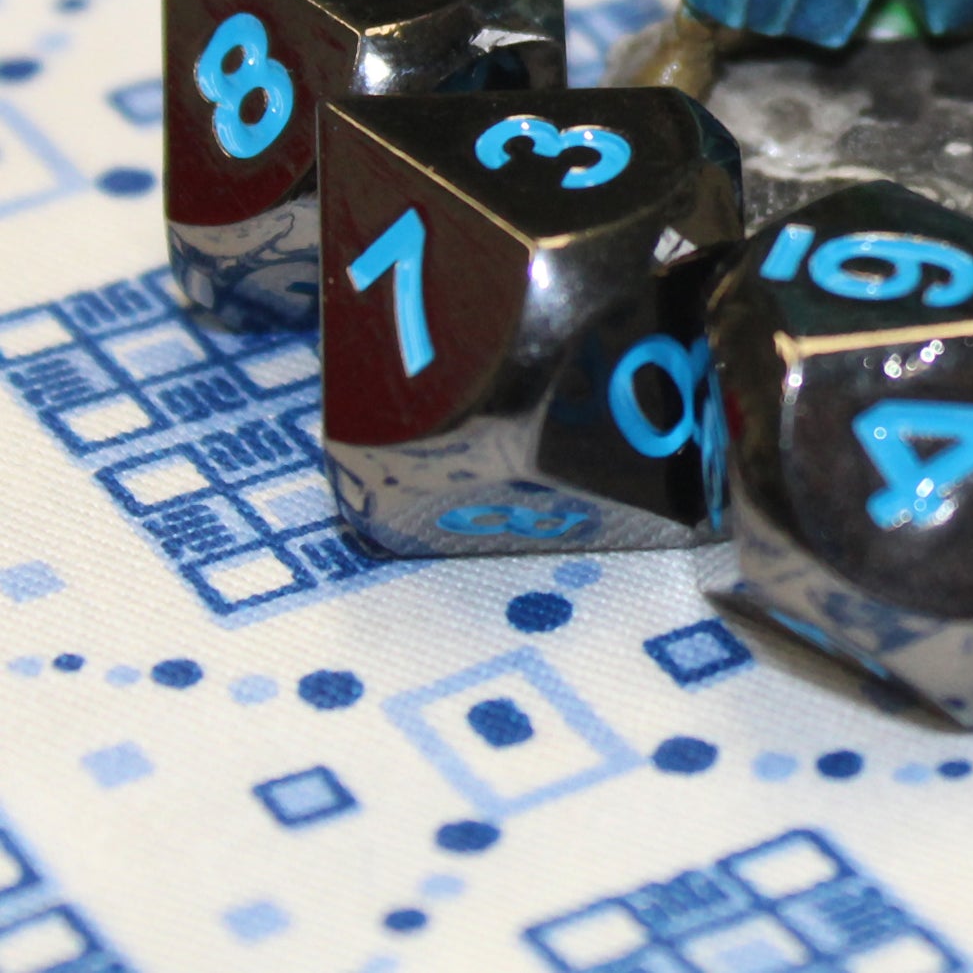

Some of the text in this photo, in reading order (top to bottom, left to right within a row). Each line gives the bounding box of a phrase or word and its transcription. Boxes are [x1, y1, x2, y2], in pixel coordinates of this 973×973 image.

[193, 12, 294, 159] 8
[474, 114, 633, 190] 3
[346, 206, 435, 378] 7
